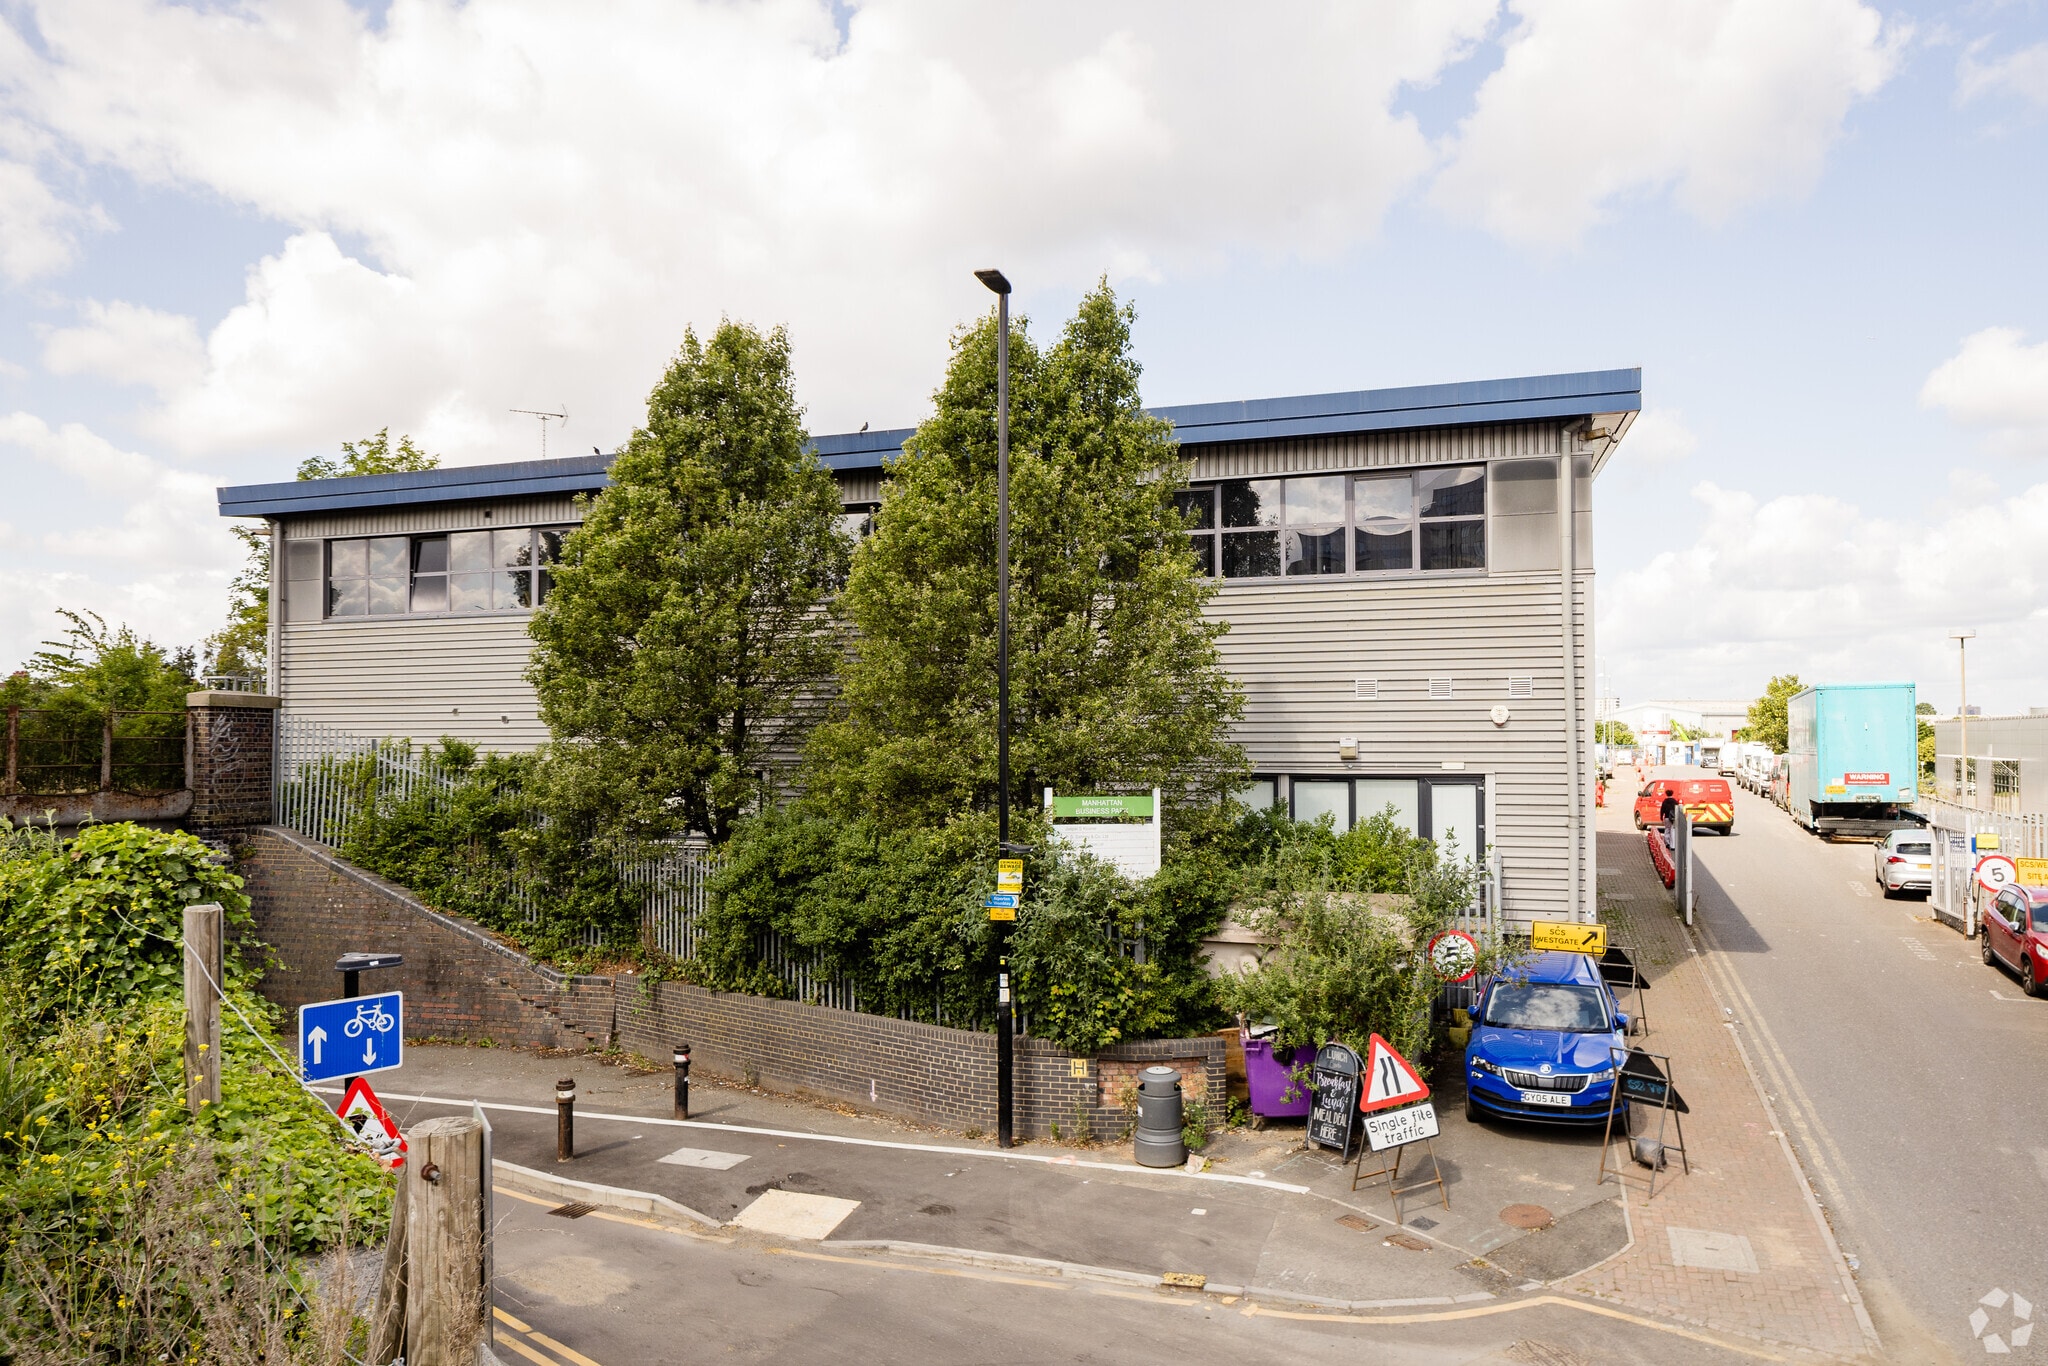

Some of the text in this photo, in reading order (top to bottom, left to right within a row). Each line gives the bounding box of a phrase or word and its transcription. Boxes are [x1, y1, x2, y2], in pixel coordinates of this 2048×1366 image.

[1992, 868, 2005, 882] 5
[1549, 928, 1566, 936] SCS
[1536, 936, 1578, 945] WESTGATE
[1326, 1049, 1348, 1063] LUNCH
[1321, 1093, 1345, 1113] Lunch
[1524, 1093, 1567, 1105] GY05 ALE
[1313, 1106, 1348, 1127] MEAL DEAL
[1369, 1109, 1433, 1133] Single file
[1320, 1125, 1338, 1141] HERE
[1385, 1126, 1425, 1144] traffic
